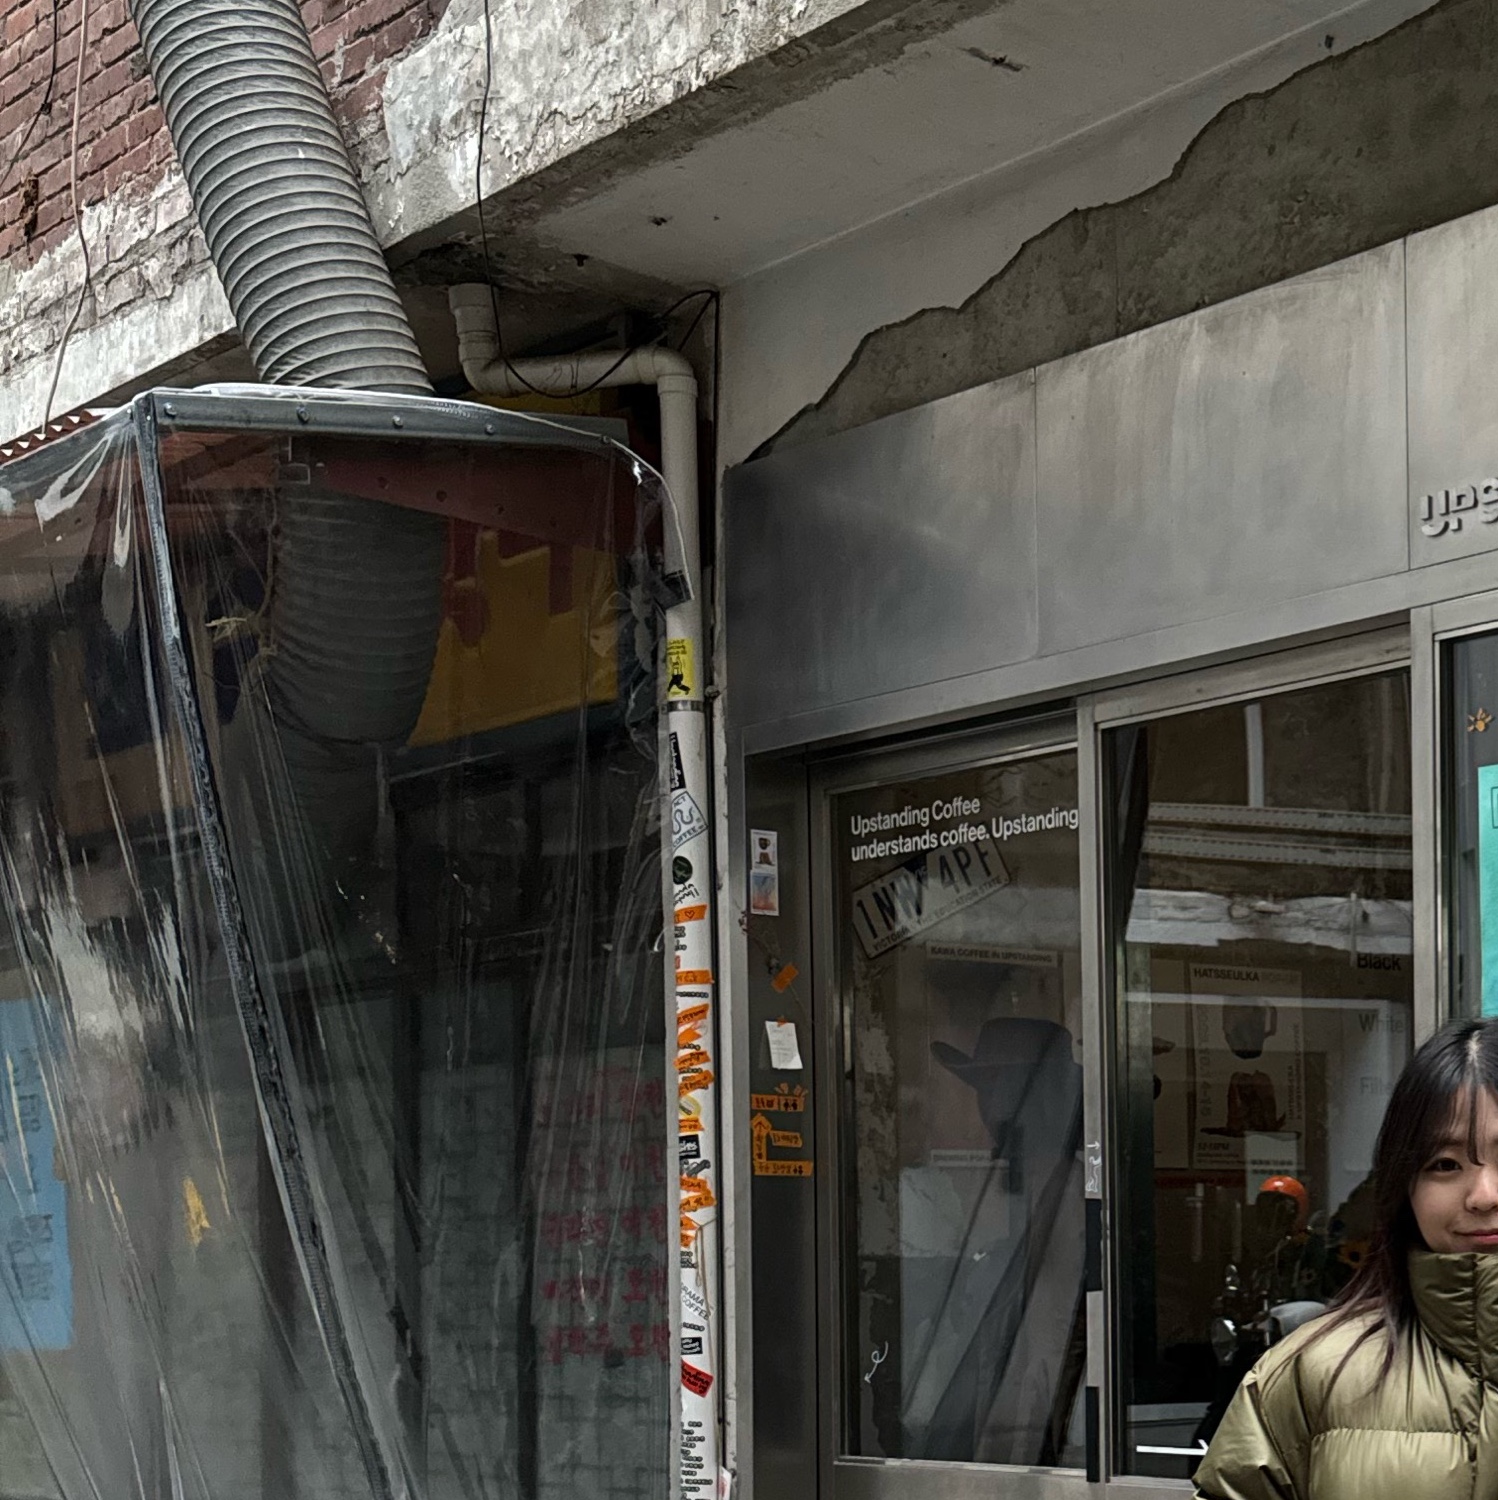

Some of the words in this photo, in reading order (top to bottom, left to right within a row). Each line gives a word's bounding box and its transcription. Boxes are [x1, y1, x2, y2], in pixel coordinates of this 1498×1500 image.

[851, 805, 929, 838] Upstanding
[932, 796, 981, 821] Coffee
[851, 830, 938, 862] understands
[940, 821, 990, 847] coffee.
[991, 806, 1079, 840] Upstanding
[1357, 951, 1402, 971] Black
